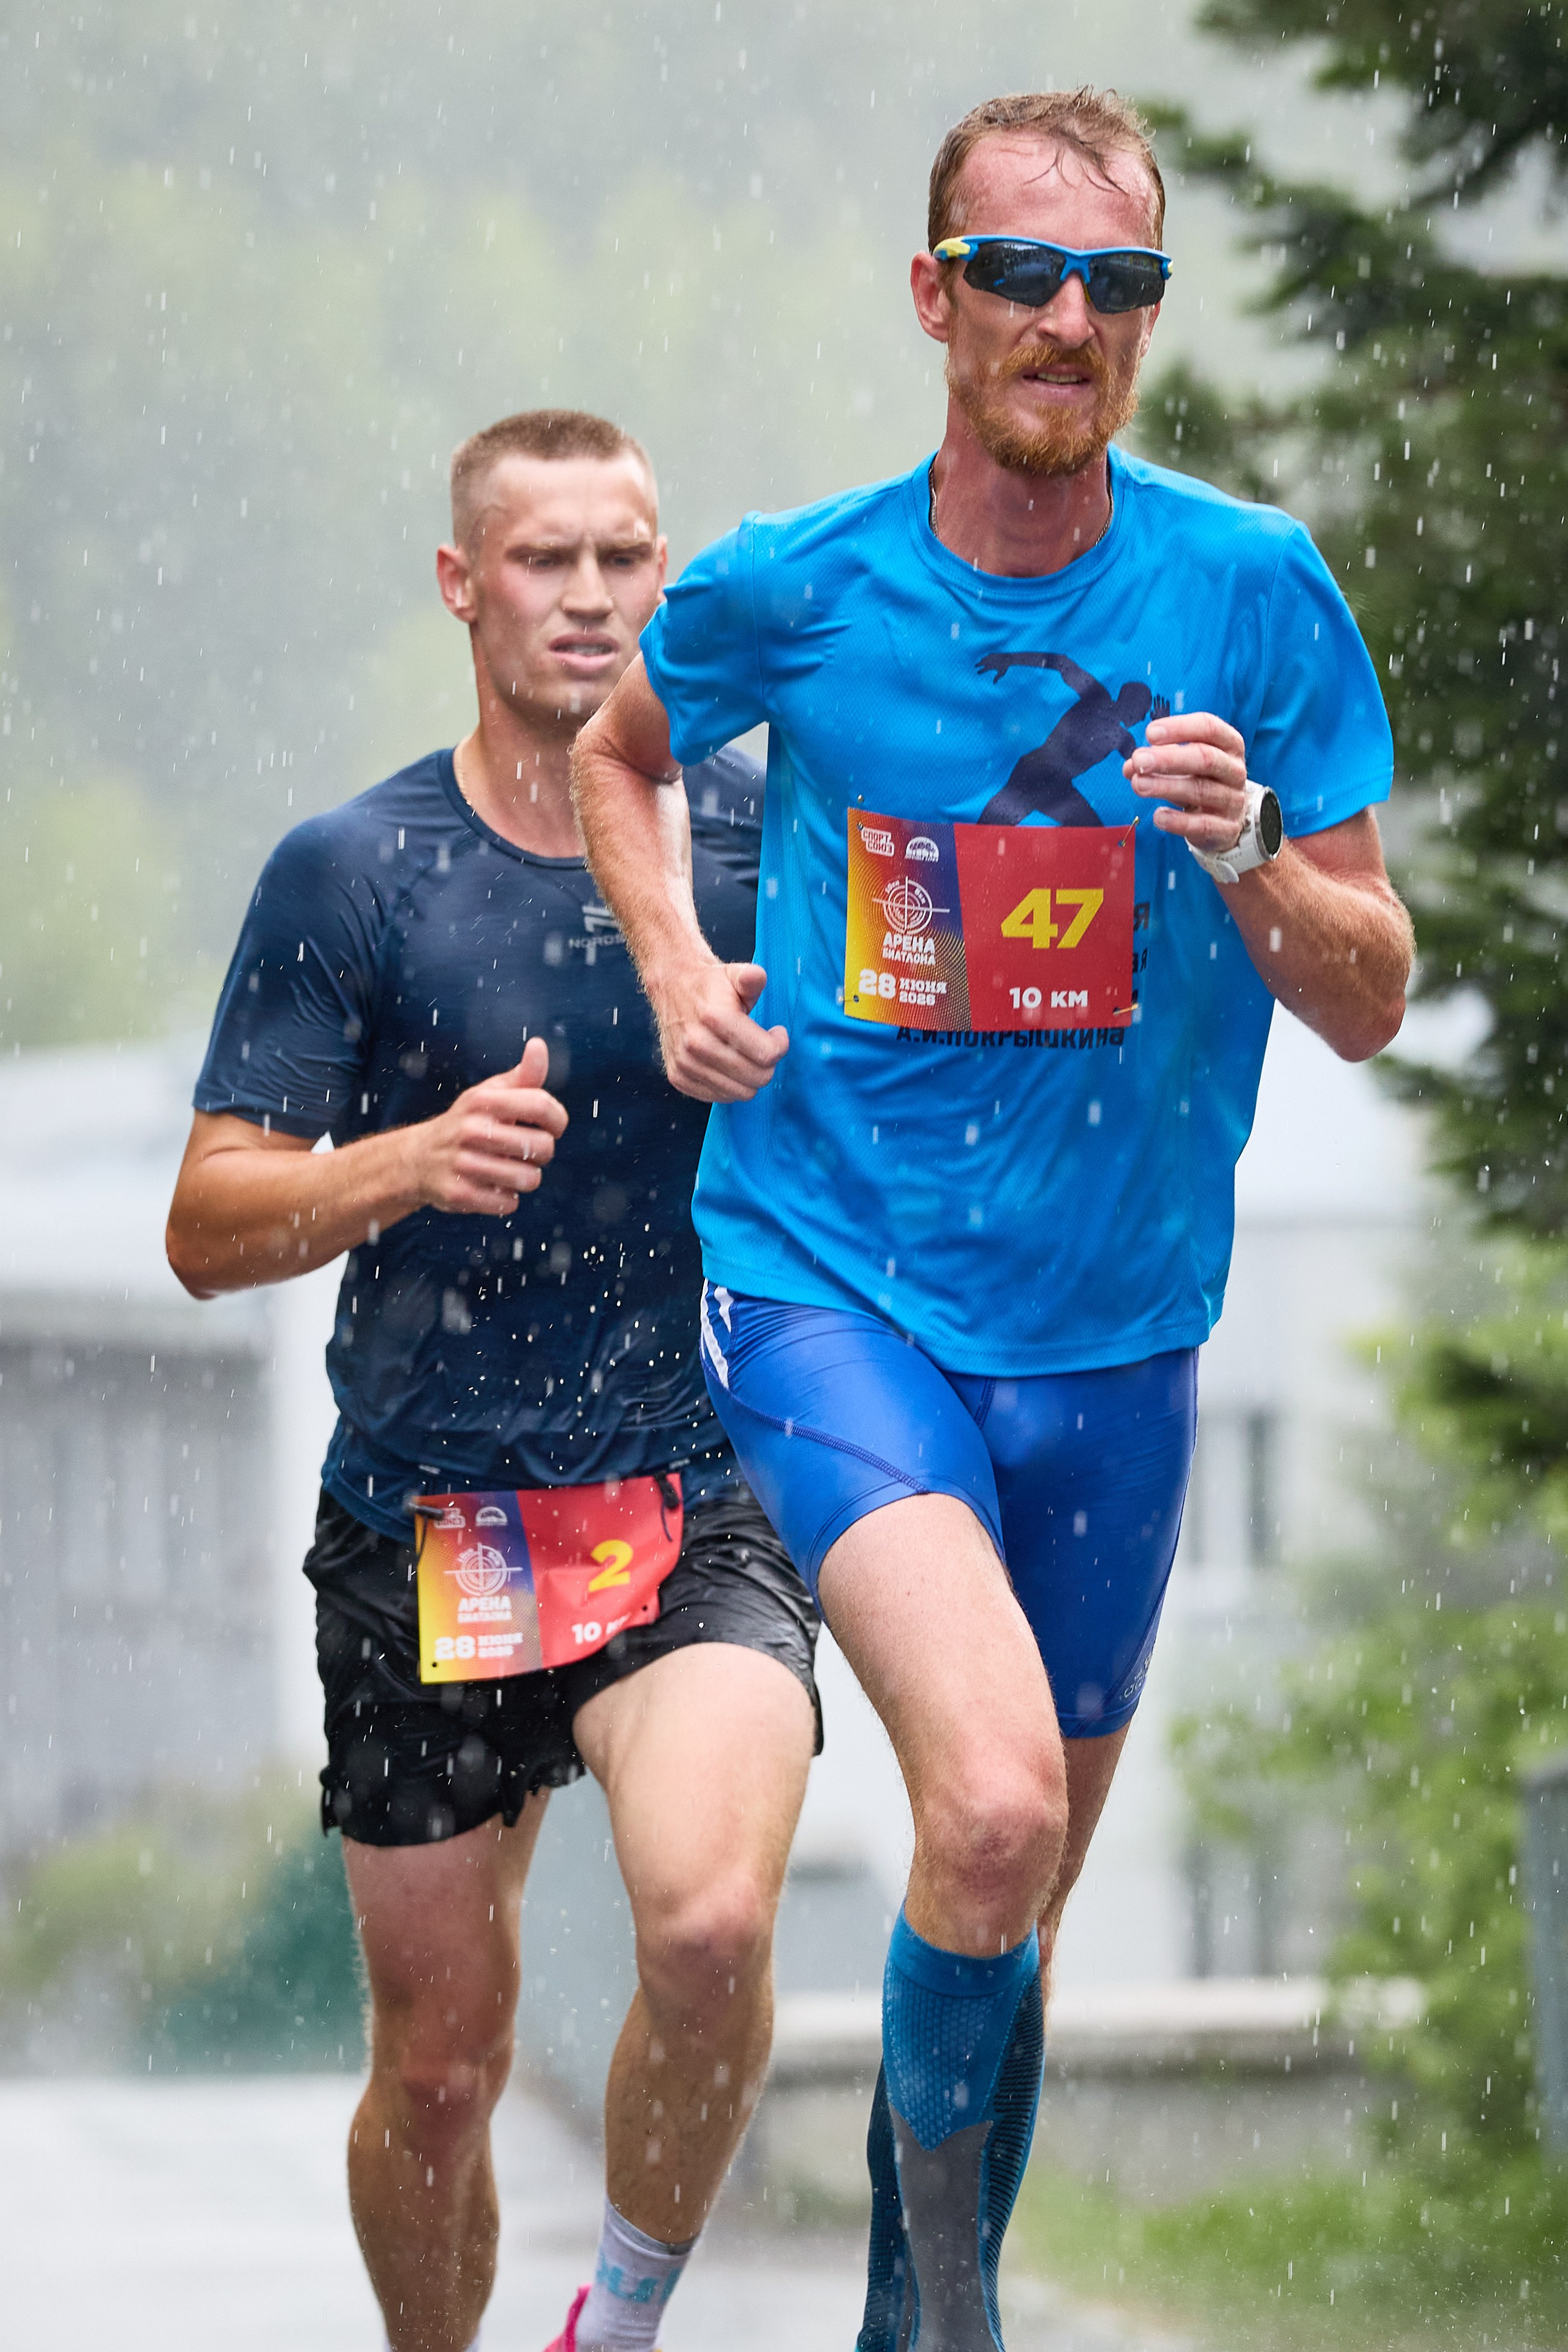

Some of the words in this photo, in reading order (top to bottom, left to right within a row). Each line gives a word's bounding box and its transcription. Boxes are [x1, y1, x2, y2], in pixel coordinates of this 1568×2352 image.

[1000, 888, 1104, 949] 47
[883, 931, 936, 955] АРЕНА
[882, 947, 936, 966] БИАТЛОНА
[858, 969, 896, 999] 28
[899, 977, 948, 994] ИЮНЯ
[1009, 987, 1042, 1009] 10
[588, 1540, 633, 1593] 2
[458, 1595, 512, 1613] АРЕНА
[571, 1621, 602, 1644] 10
[434, 1635, 476, 1660] 28
